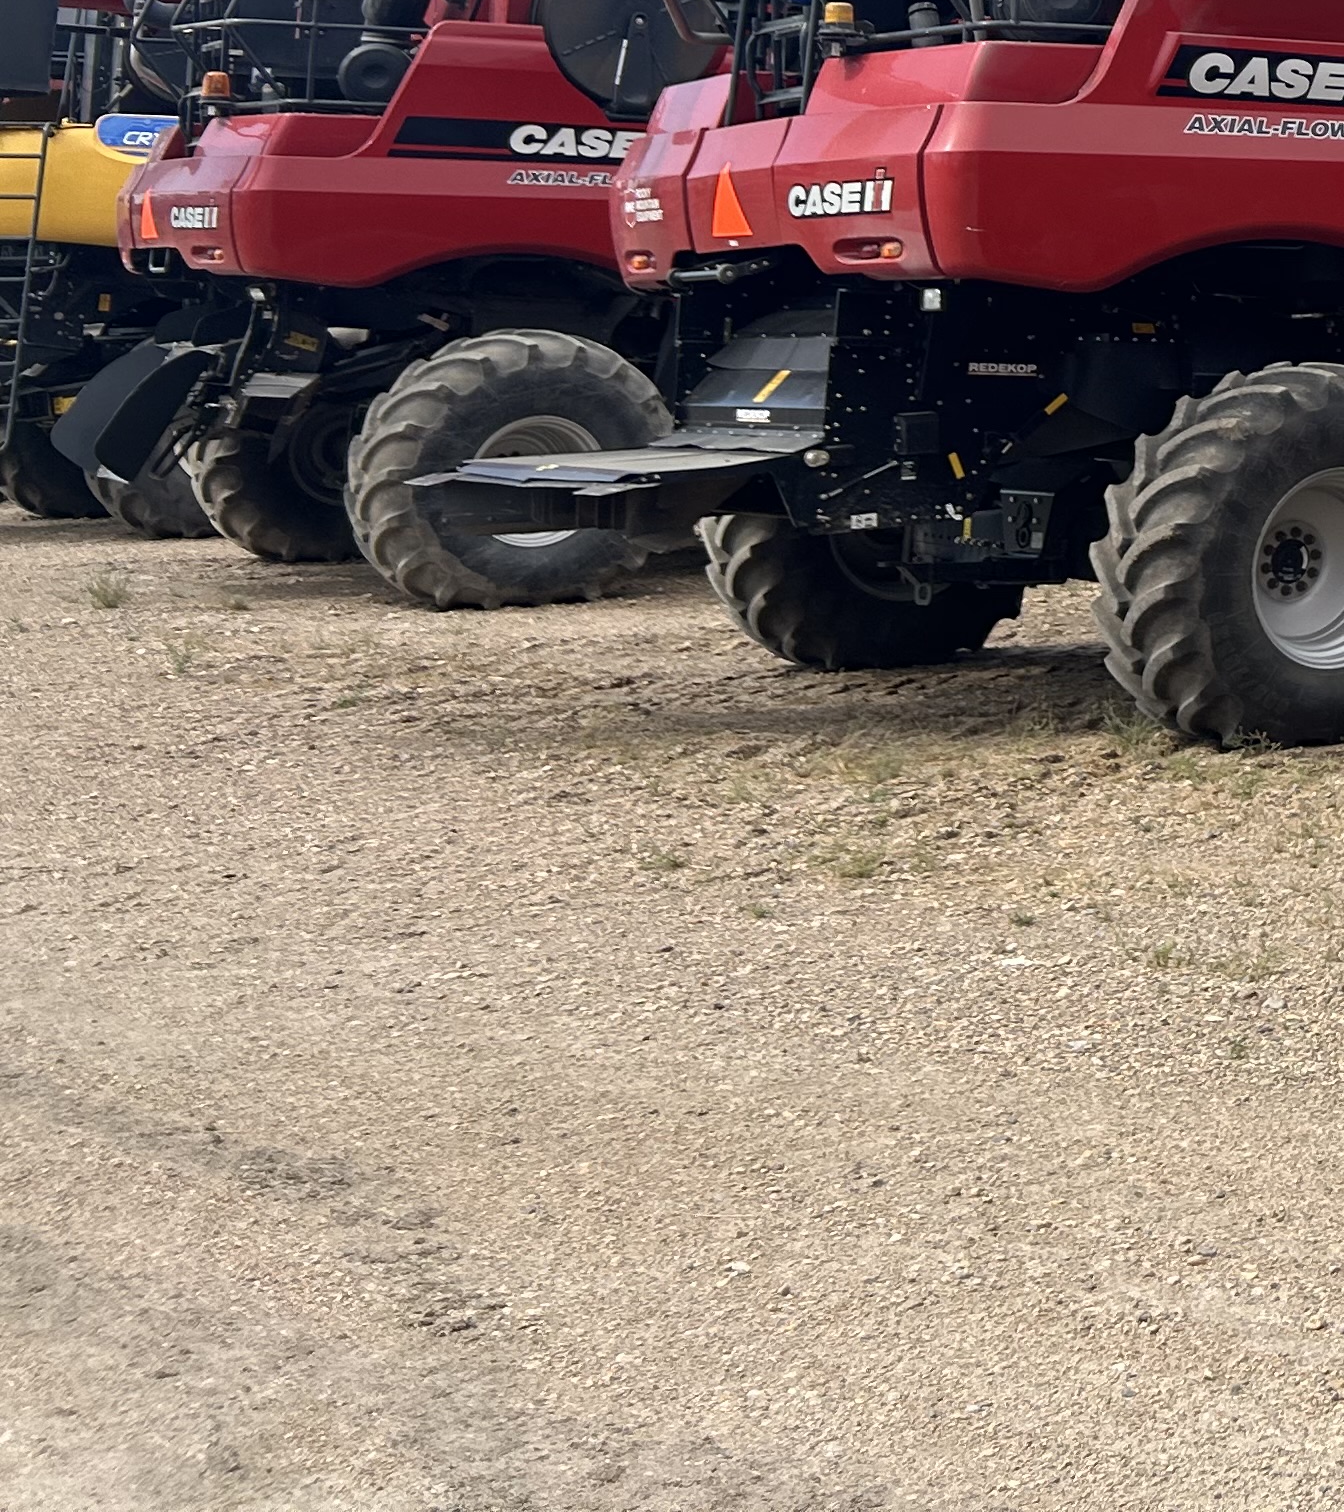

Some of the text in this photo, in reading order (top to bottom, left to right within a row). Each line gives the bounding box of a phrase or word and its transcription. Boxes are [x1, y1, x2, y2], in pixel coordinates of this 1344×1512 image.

[788, 184, 862, 217] CASE
[170, 206, 204, 228] CASE
[968, 362, 1037, 373] REDEKOP
